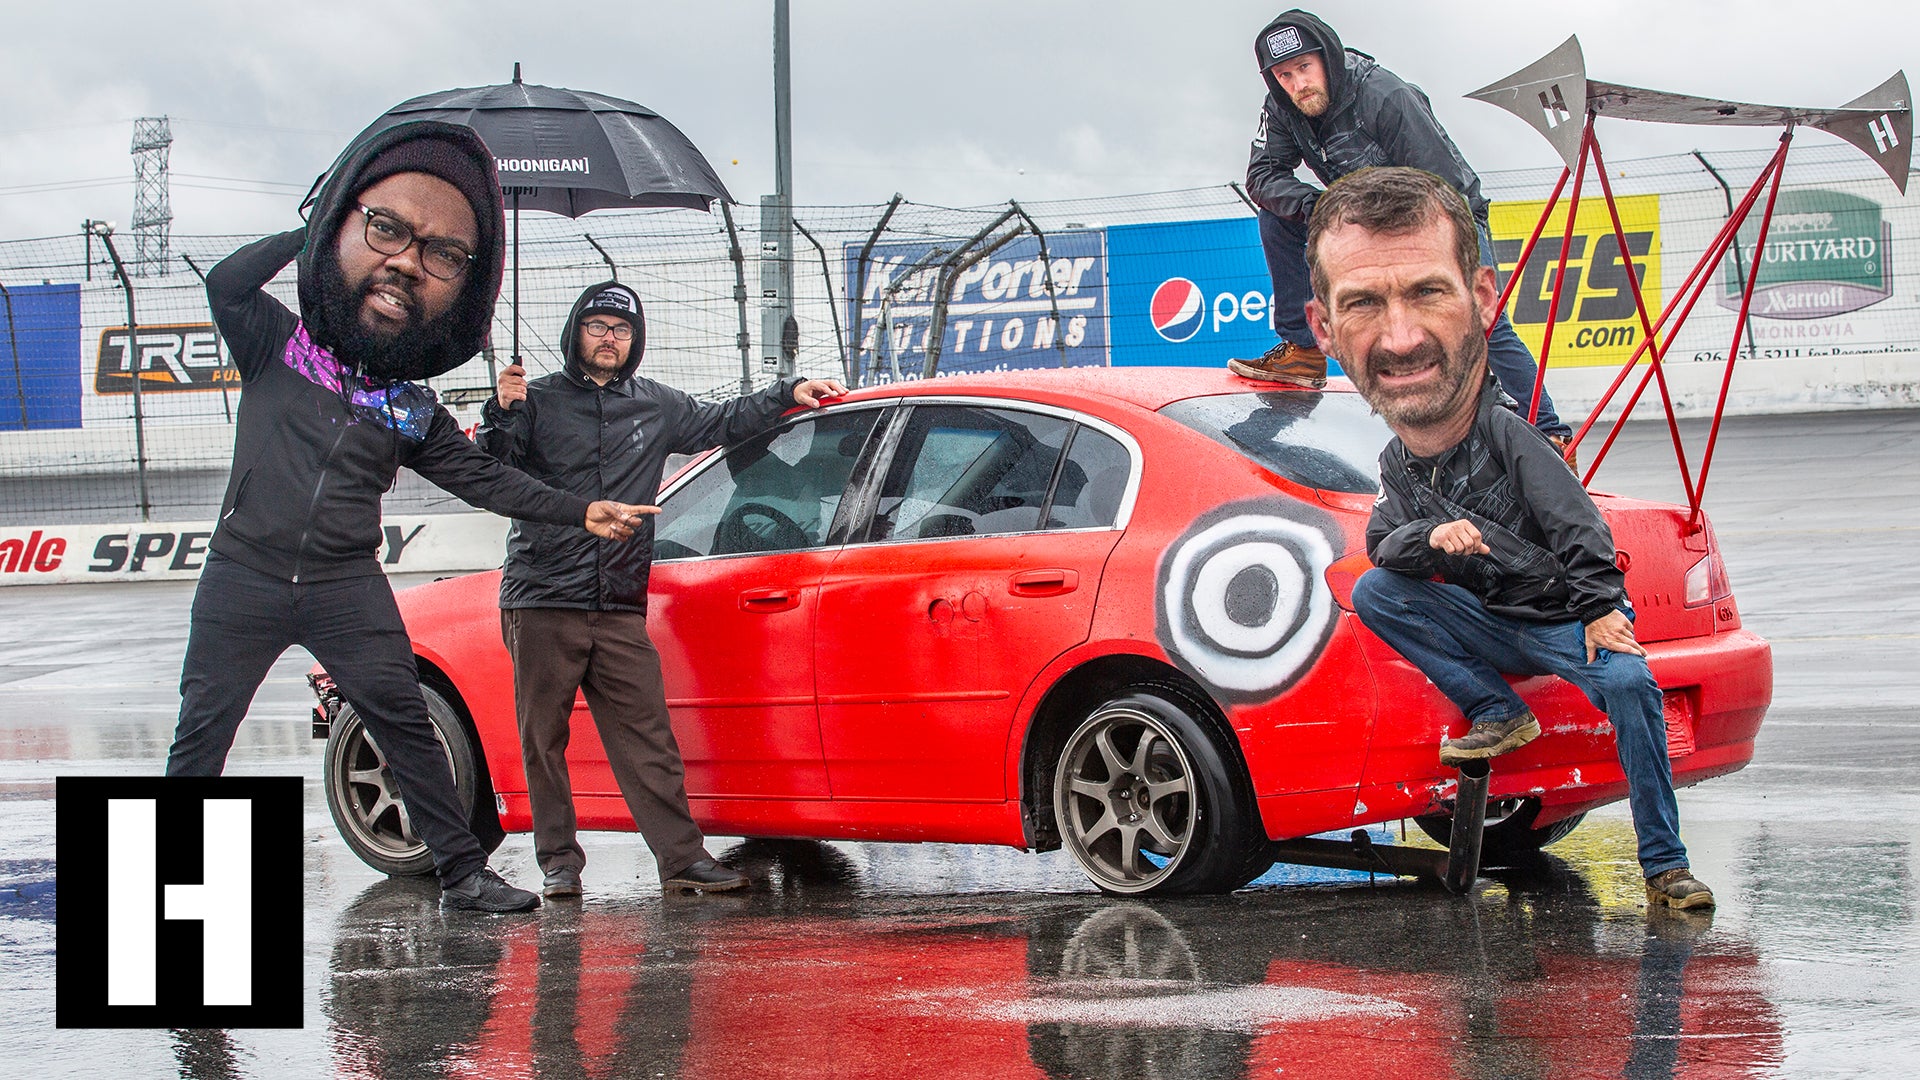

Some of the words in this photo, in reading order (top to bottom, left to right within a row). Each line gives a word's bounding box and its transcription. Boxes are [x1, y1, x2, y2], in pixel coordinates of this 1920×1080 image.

[1538, 84, 1571, 129] H
[1868, 113, 1899, 154] H
[494, 156, 590, 174] HOONIGAN]
[1729, 237, 1876, 265] COURTYARD
[952, 248, 1094, 302] Porter
[1763, 287, 1844, 313] Marriott
[1568, 326, 1635, 349] .com
[1754, 322, 1854, 339] MONROVIA
